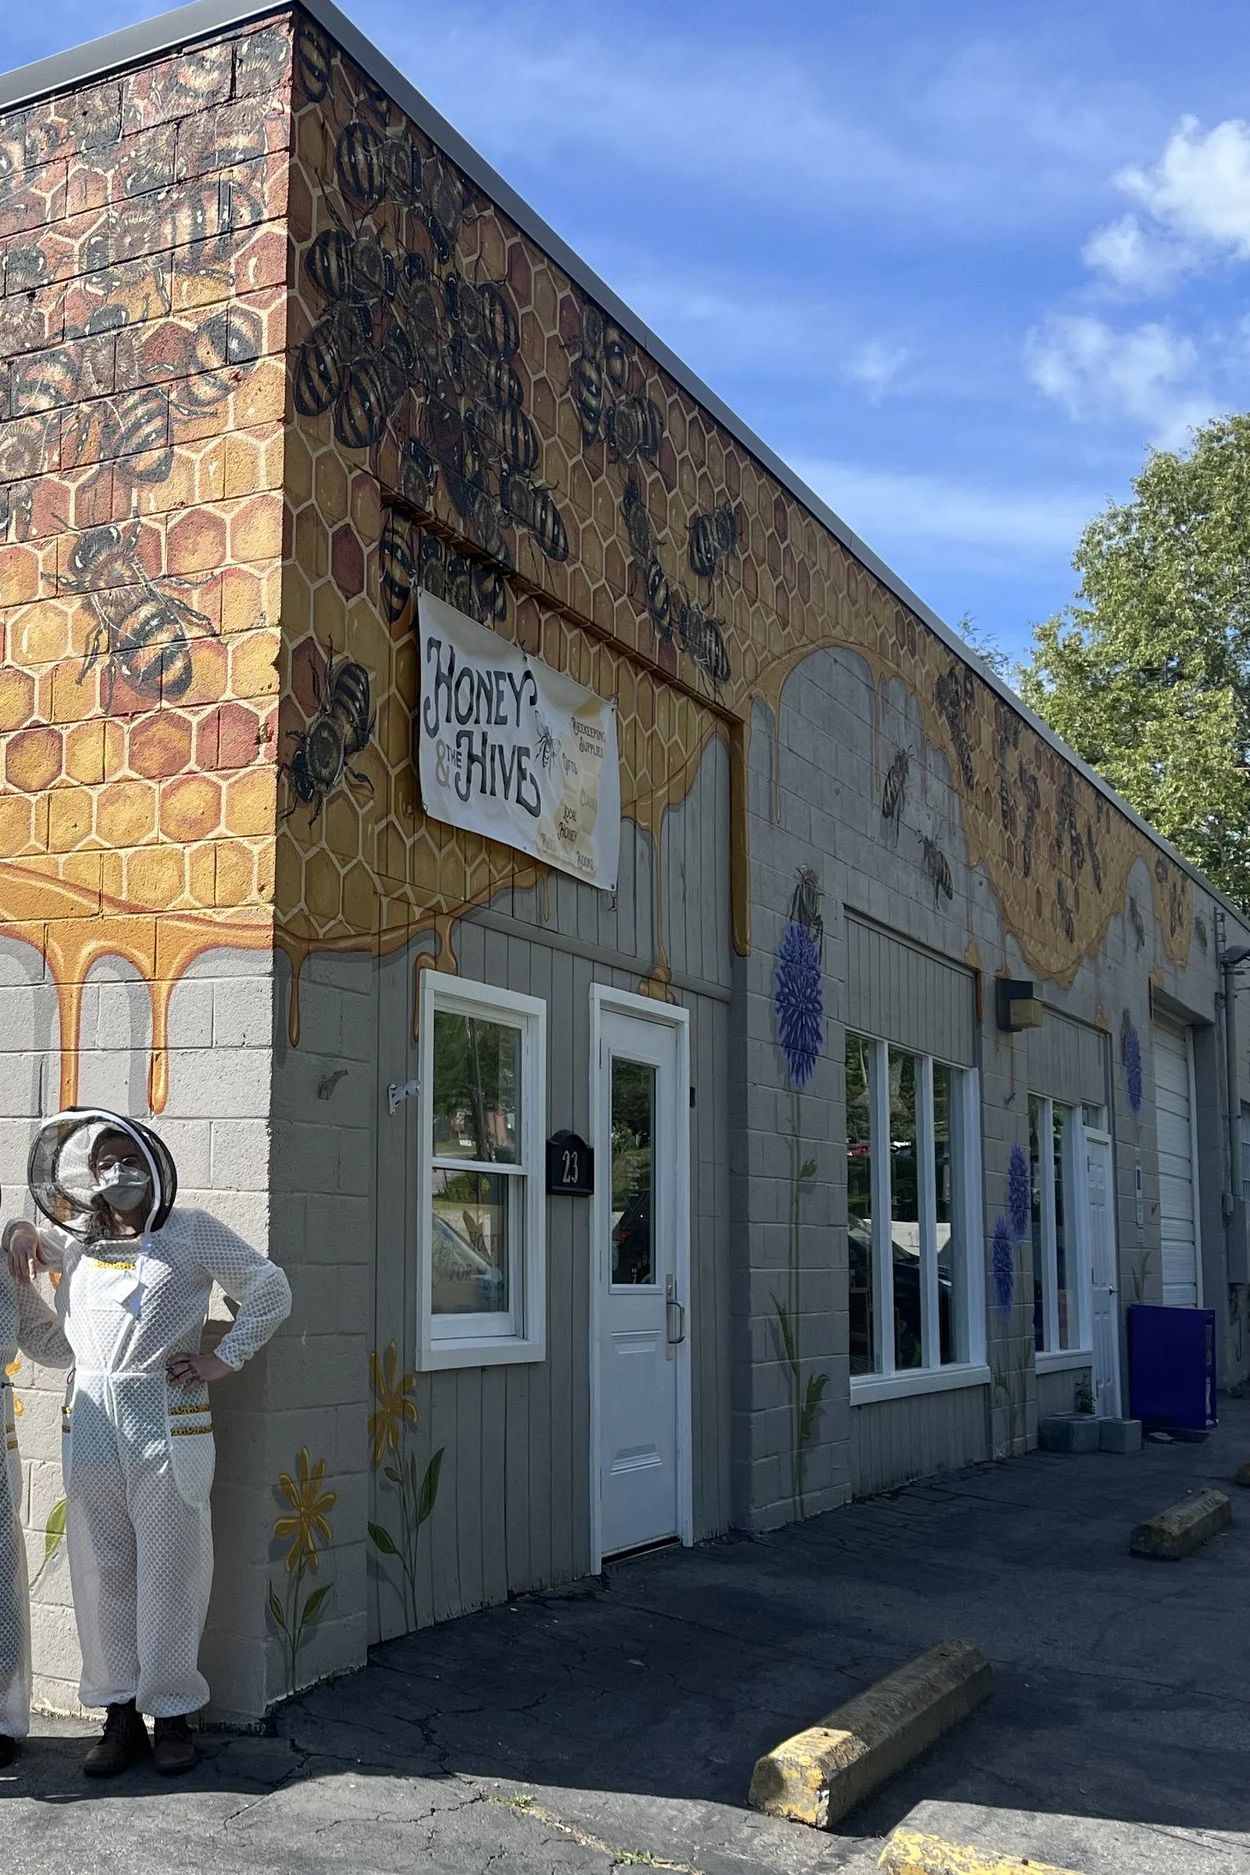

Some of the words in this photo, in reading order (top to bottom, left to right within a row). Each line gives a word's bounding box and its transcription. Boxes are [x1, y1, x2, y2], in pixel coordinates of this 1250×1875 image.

[424, 636, 538, 739] HONEY
[435, 738, 450, 789] &
[446, 743, 463, 770] THE
[454, 729, 542, 818] HIVE
[563, 803, 578, 823] LOCAL
[557, 821, 580, 842] HONEY
[562, 1150, 578, 1183] 23
